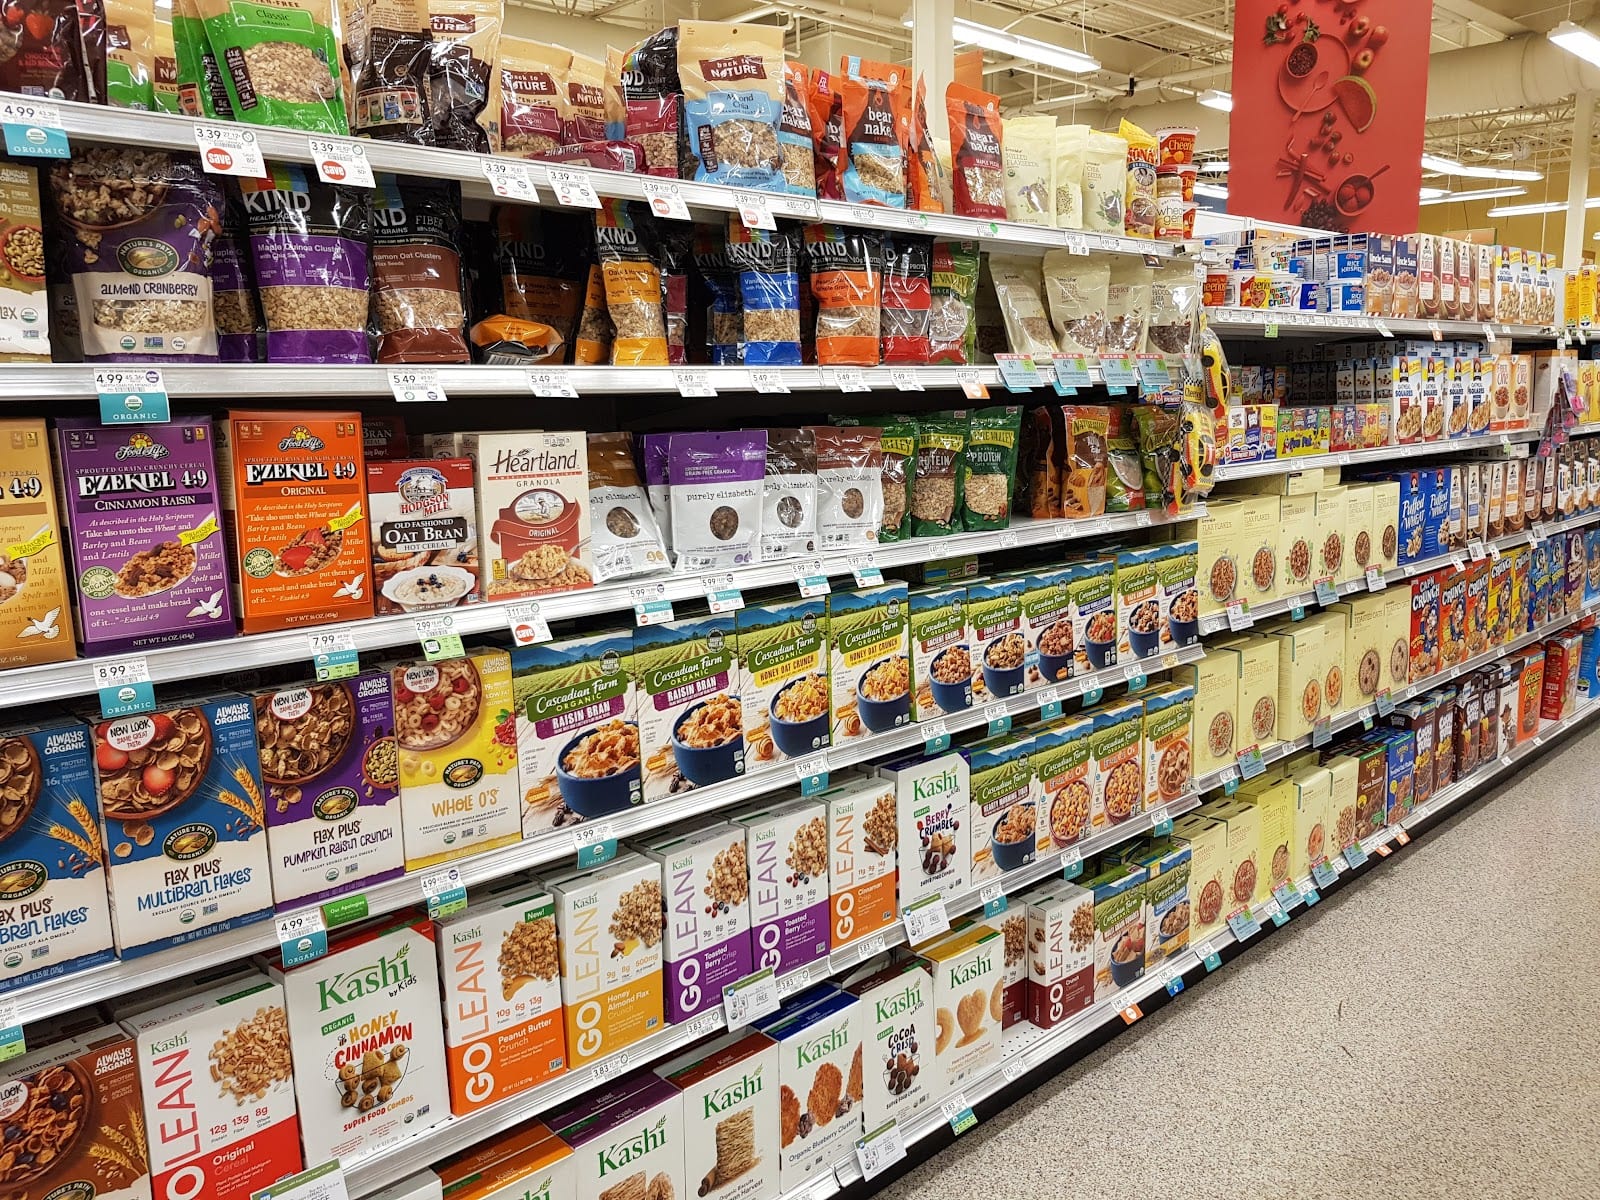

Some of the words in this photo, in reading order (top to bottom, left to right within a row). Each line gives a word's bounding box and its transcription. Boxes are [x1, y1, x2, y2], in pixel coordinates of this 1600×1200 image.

[256, 9, 291, 21] Classic
[711, 65, 757, 78] NATURE
[869, 106, 892, 122] bear
[968, 130, 993, 143] bear
[13, 146, 65, 155] ORGANIC
[971, 141, 1000, 154] naked
[207, 152, 231, 165] save
[323, 164, 345, 176] save
[242, 190, 311, 213] KIND
[416, 215, 443, 227] FIBER
[597, 227, 637, 244] KIND
[1464, 231, 1472, 243] 4
[807, 243, 847, 256] KIND
[1382, 255, 1391, 263] Sam
[1408, 258, 1416, 266] Sam
[112, 412, 157, 420] ORGANIC
[488, 448, 578, 474] Heartland
[246, 464, 328, 480] EZEKIEL
[333, 463, 356, 479] 4:9
[10, 478, 41, 495] 4:9
[77, 471, 175, 496] EZEKIEL
[181, 471, 208, 488] 4:9
[281, 486, 326, 496] ORIGINAL
[516, 479, 561, 488] GRANOLA
[95, 498, 159, 511] CINNAMON
[161, 496, 195, 505] RAISIN
[400, 494, 449, 514] HODGSON
[424, 503, 448, 516] MILL
[411, 518, 454, 527] FASHIONED
[385, 530, 416, 543] OAT
[421, 527, 464, 540] BRAN
[528, 527, 559, 538] ORIGINAL
[82, 542, 108, 551] Barley
[110, 539, 126, 547] and
[128, 537, 151, 546] Beans
[199, 542, 213, 550] and
[404, 543, 419, 551] HOT
[421, 541, 449, 549] CEREAL
[101, 550, 130, 559] Lentils
[199, 551, 221, 560] Millet
[197, 563, 211, 571] and
[106, 606, 129, 614] vessel
[131, 603, 146, 612] and
[148, 602, 168, 610] make
[170, 598, 191, 607] bread
[1413, 584, 1440, 611] CRUNCH
[845, 626, 881, 647] Cascadian
[882, 619, 898, 634] Farm
[922, 619, 947, 637] Cascadian
[948, 614, 961, 625] Farm
[858, 631, 888, 646] ORGANIC
[755, 642, 794, 666] Cascadian
[795, 635, 815, 652] Farm
[850, 647, 867, 660] HONEY
[867, 645, 877, 655] OAT
[878, 639, 898, 652] CRUNCH
[653, 663, 700, 688] Cascadian
[701, 654, 722, 668] Farm
[760, 667, 779, 680] HONEY
[781, 663, 792, 675] OAT
[794, 654, 814, 670] CRUNCH
[359, 677, 388, 691] ALWAYS
[670, 669, 709, 686] ORGANIC
[358, 686, 389, 698] ORGANIC
[536, 688, 591, 713] Cascadian
[593, 678, 618, 693] Farm
[667, 683, 695, 702] RAISIN
[697, 676, 717, 693] BRAN
[107, 701, 151, 714] ORGANIC
[273, 697, 292, 707] NEW
[292, 691, 308, 703] LOOK
[556, 692, 602, 712] ORGANIC
[214, 711, 251, 725] ORGANIC
[215, 703, 249, 719] ALWAYS
[553, 707, 586, 730] RAISIN
[588, 701, 610, 720] BRAN
[109, 724, 127, 738] NEW
[129, 719, 151, 733] LOOK
[46, 731, 84, 747] ALWAYS
[44, 741, 86, 756] ORGANIC
[913, 768, 959, 801] Kashi
[925, 807, 950, 825] BERRY
[339, 821, 361, 837] PLUS
[920, 818, 955, 839] CRUMBLE
[191, 859, 221, 877] PLUS
[856, 881, 882, 896] Cinnamon
[573, 892, 600, 911] Kashi
[527, 909, 545, 920] New!
[784, 913, 807, 927] Toasted
[452, 926, 484, 945] Kashi
[287, 948, 324, 965] ORGANIC
[704, 944, 728, 960] Toasted
[949, 957, 992, 990] Kashi
[315, 956, 411, 1012] Kashi
[607, 989, 630, 1004] Honey
[608, 997, 635, 1012] Almond
[636, 990, 650, 999] Flax
[875, 986, 922, 1024] Kashi
[323, 1015, 354, 1034] ORGANIC
[349, 1010, 398, 1044] HONEY
[498, 1027, 526, 1045] Peanut
[528, 1018, 553, 1036] Butter
[150, 1031, 189, 1055] Kashi
[498, 1035, 529, 1054] Crunch
[888, 1023, 915, 1049] COCOA
[334, 1022, 413, 1070] CINNAMON
[797, 1024, 850, 1068] Kashi
[891, 1036, 914, 1059] CRISP
[94, 1055, 133, 1076] ORGANIC
[96, 1048, 132, 1069] ALWAYS
[703, 1072, 764, 1120] Kashi
[212, 1140, 255, 1165] Original
[597, 1123, 667, 1179] Kashi
[214, 1156, 249, 1176] Cereal
